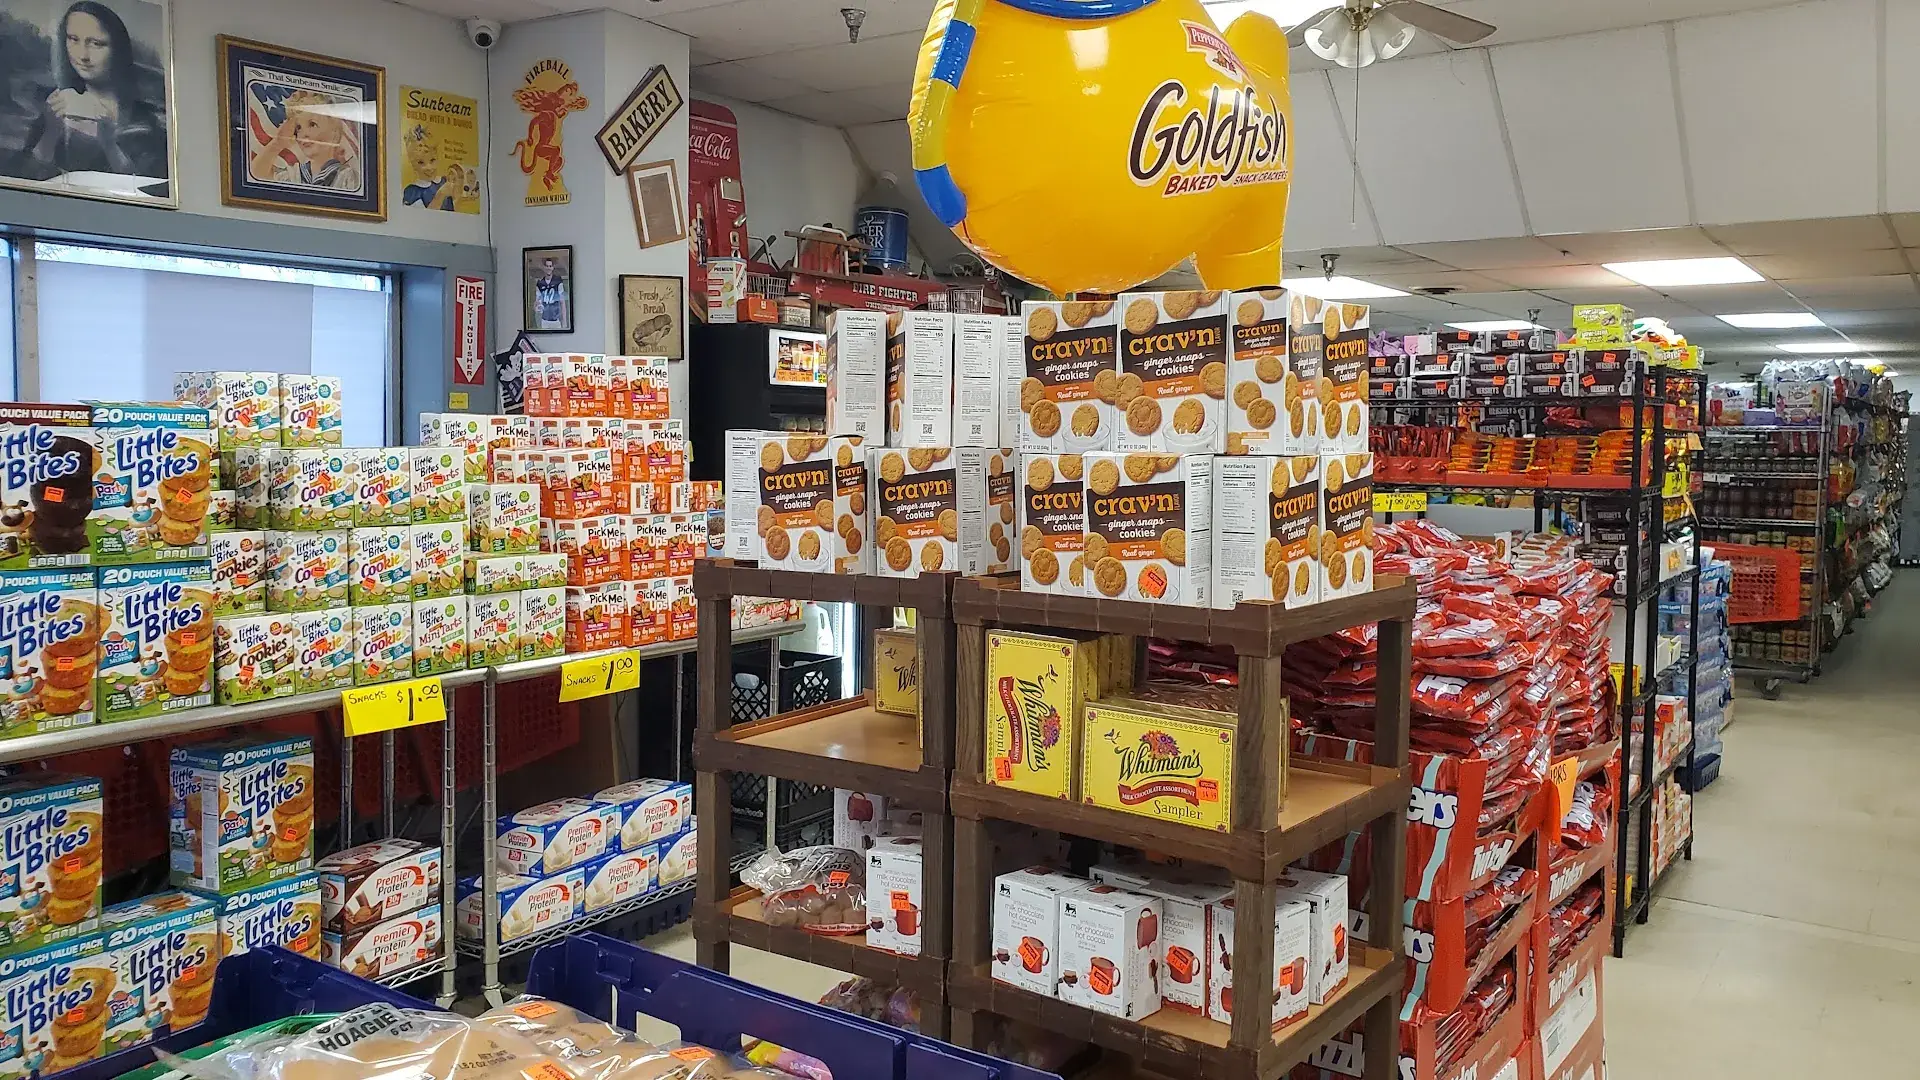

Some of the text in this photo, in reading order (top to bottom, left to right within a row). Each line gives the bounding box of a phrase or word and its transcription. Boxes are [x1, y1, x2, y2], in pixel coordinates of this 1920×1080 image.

[1191, 28, 1229, 54] PEPPERIDGE
[525, 59, 570, 85] FIREBALL
[268, 72, 341, 92] That Sunbeam Smile
[406, 89, 472, 117] Sunbeam
[608, 79, 673, 160] BAKERY
[1129, 81, 1287, 182] Goldfish
[1164, 170, 1288, 195] BAKED SNACK CRACKERS
[458, 284, 483, 300] FIRE
[638, 286, 659, 301] Fresh
[878, 286, 918, 302] FIGHTER
[643, 302, 666, 314] Bread
[466, 299, 474, 377] EXTINGUISHER
[1143, 352, 1205, 370] ginger snaps
[1055, 370, 1089, 382] cookies
[1155, 365, 1195, 377] cookies
[224, 380, 246, 397] Little
[254, 381, 266, 389] 30
[1157, 385, 1194, 395] Real ginger
[232, 389, 254, 403] Bites
[93, 408, 207, 423] 20 POUCH VALUE PACK
[116, 428, 178, 473] Little
[136, 453, 198, 488] Bites
[360, 456, 380, 472] Little
[367, 466, 387, 479] Bites
[414, 456, 432, 472] Little
[420, 464, 439, 477] Bites
[775, 489, 818, 504] ginger snaps
[783, 499, 811, 510] cookies
[796, 518, 812, 526] ginger
[905, 509, 934, 520] cookies
[1107, 516, 1165, 533] ginger snaps
[1119, 528, 1156, 539] cookies
[209, 540, 231, 558] Little
[216, 549, 239, 563] Bites
[1121, 548, 1156, 557] Real ginger
[103, 565, 211, 584] 20 POUCH VALUE PACK
[125, 582, 182, 629] Little
[145, 602, 202, 643] Bites
[420, 606, 438, 623] Little
[426, 613, 444, 628] Bites
[17, 614, 84, 658] Bites
[238, 623, 260, 642] Little
[418, 616, 463, 646] Mini Tarts
[246, 632, 268, 649] Bites
[1015, 675, 1051, 773] Whitman's
[1114, 748, 1204, 784] Whitman's
[239, 760, 287, 806] Little
[256, 776, 304, 818] Bites
[1122, 791, 1134, 801] MILK
[1134, 785, 1162, 798] CHOCOLATE
[1162, 785, 1196, 797] ASSORTMENT
[1153, 799, 1203, 820] Sampler
[375, 869, 412, 889] Premier
[377, 879, 408, 896] Protein
[527, 886, 559, 903] Premier
[529, 896, 556, 912] Protein
[1070, 923, 1115, 940] milk chocolate
[1074, 930, 1106, 945] hot cocoa
[130, 931, 187, 985] Little
[149, 947, 206, 996] Bites
[318, 1010, 397, 1052] HOAGIE
[399, 1021, 414, 1033] CT
